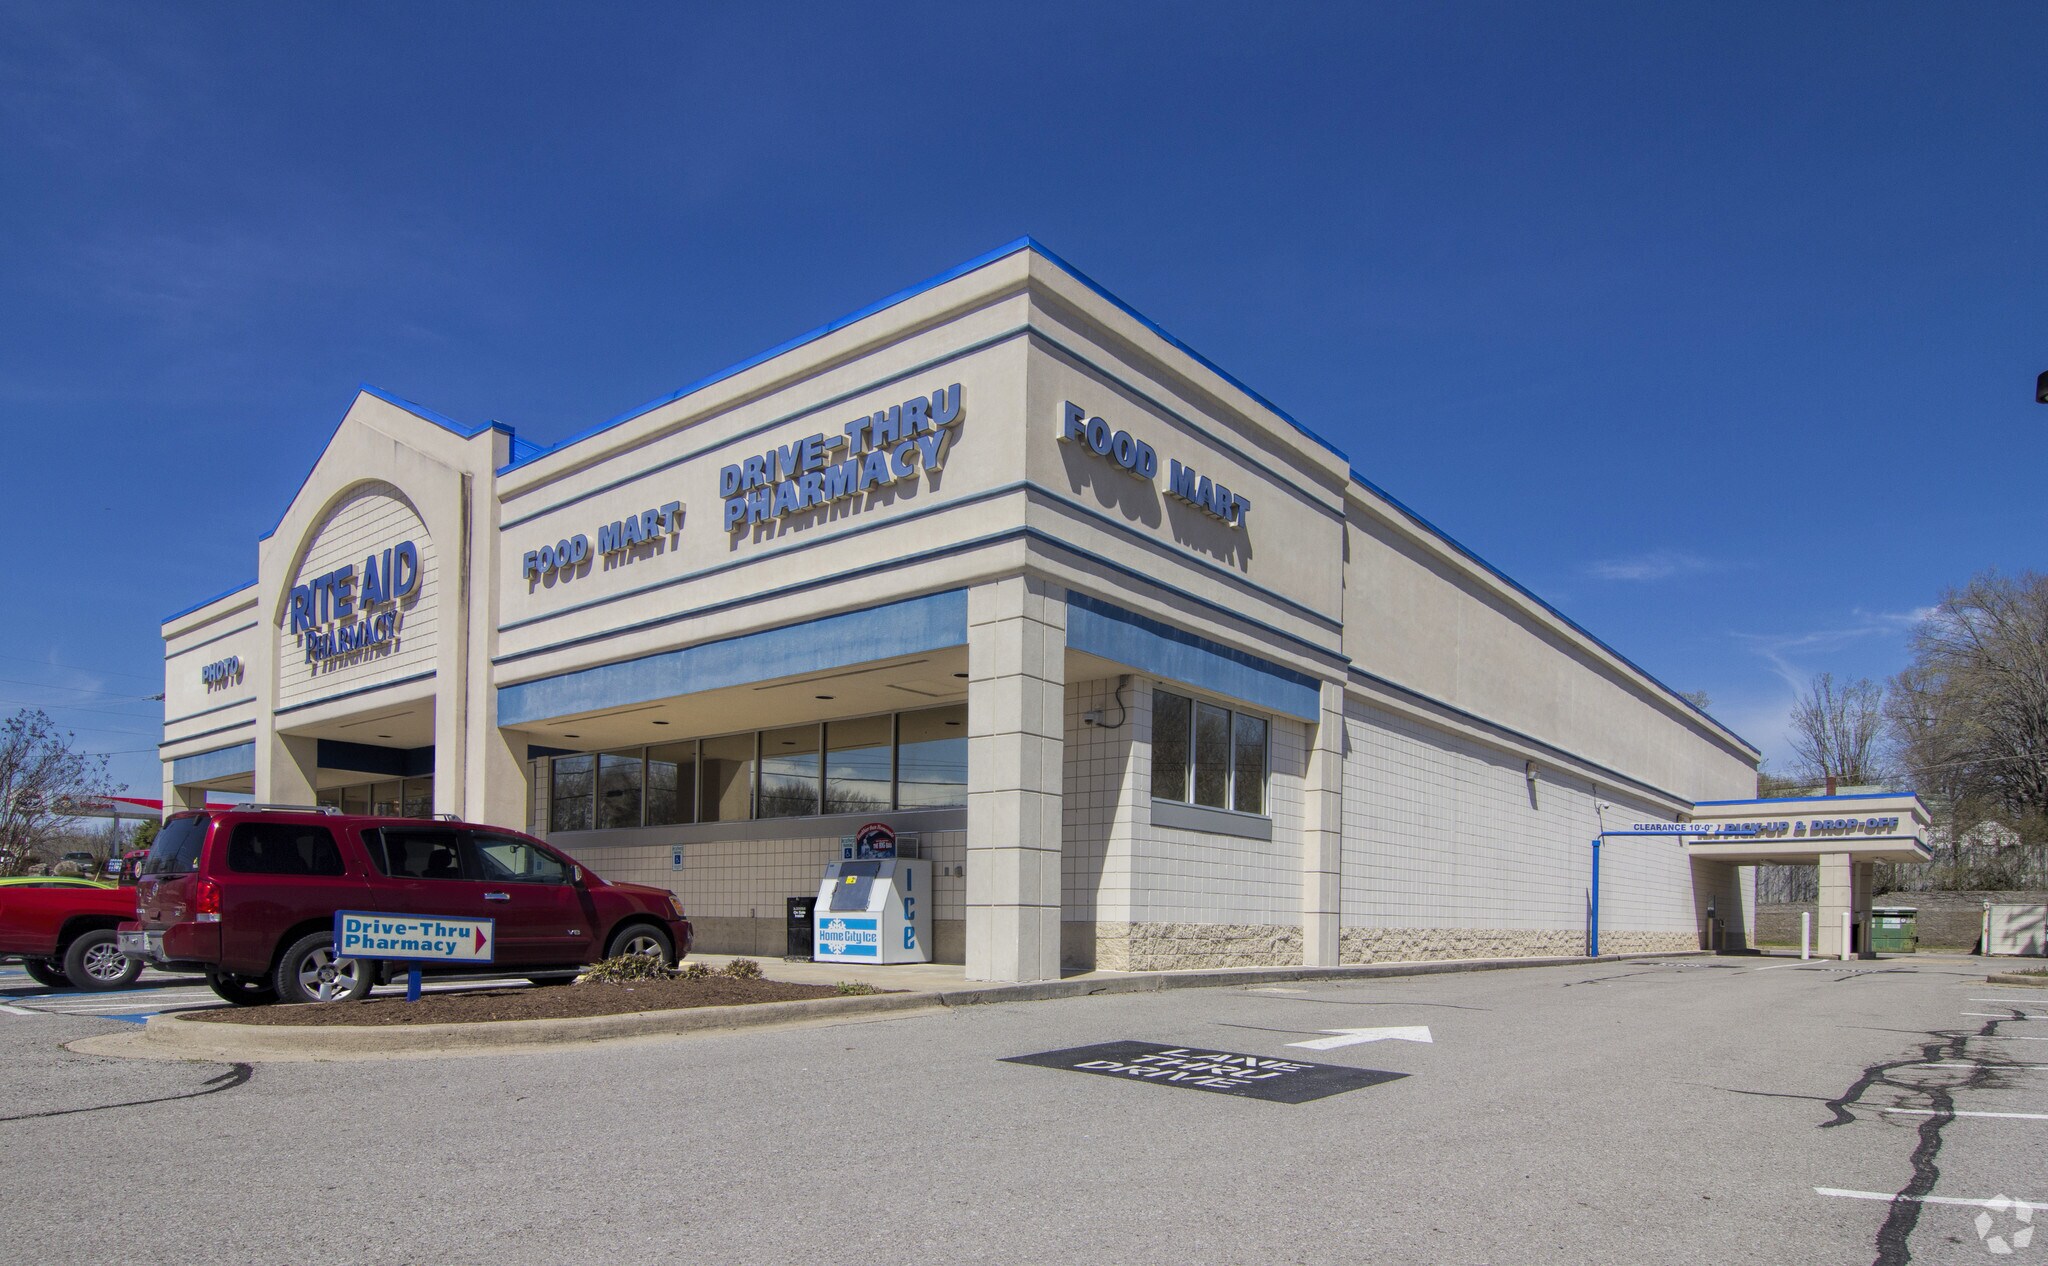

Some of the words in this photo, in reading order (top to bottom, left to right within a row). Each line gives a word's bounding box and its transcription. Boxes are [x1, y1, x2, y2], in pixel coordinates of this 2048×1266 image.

[719, 383, 964, 499] DRIVE-THRU
[1057, 400, 1158, 481] FOOD
[1162, 458, 1252, 530] MART
[723, 429, 949, 533] PHARMACY
[523, 533, 594, 580] FOOD
[598, 500, 686, 556] MART
[290, 564, 357, 635] RITE
[358, 540, 423, 609] AID
[304, 609, 399, 665] PHARMACY
[201, 655, 244, 685] PHOTO
[1633, 823, 1687, 832] CLEARANCE
[1794, 820, 1807, 831] &
[1811, 817, 1899, 831] DROP-OFF
[345, 918, 471, 938] Drive-Thru
[819, 930, 844, 941] Home
[844, 930, 862, 944] City
[862, 931, 877, 942] Ice
[345, 934, 457, 955] Pharmacy
[1072, 1060, 1254, 1089] DRIVE
[1130, 1054, 1283, 1079] THRU
[1158, 1048, 1315, 1072] LANE
